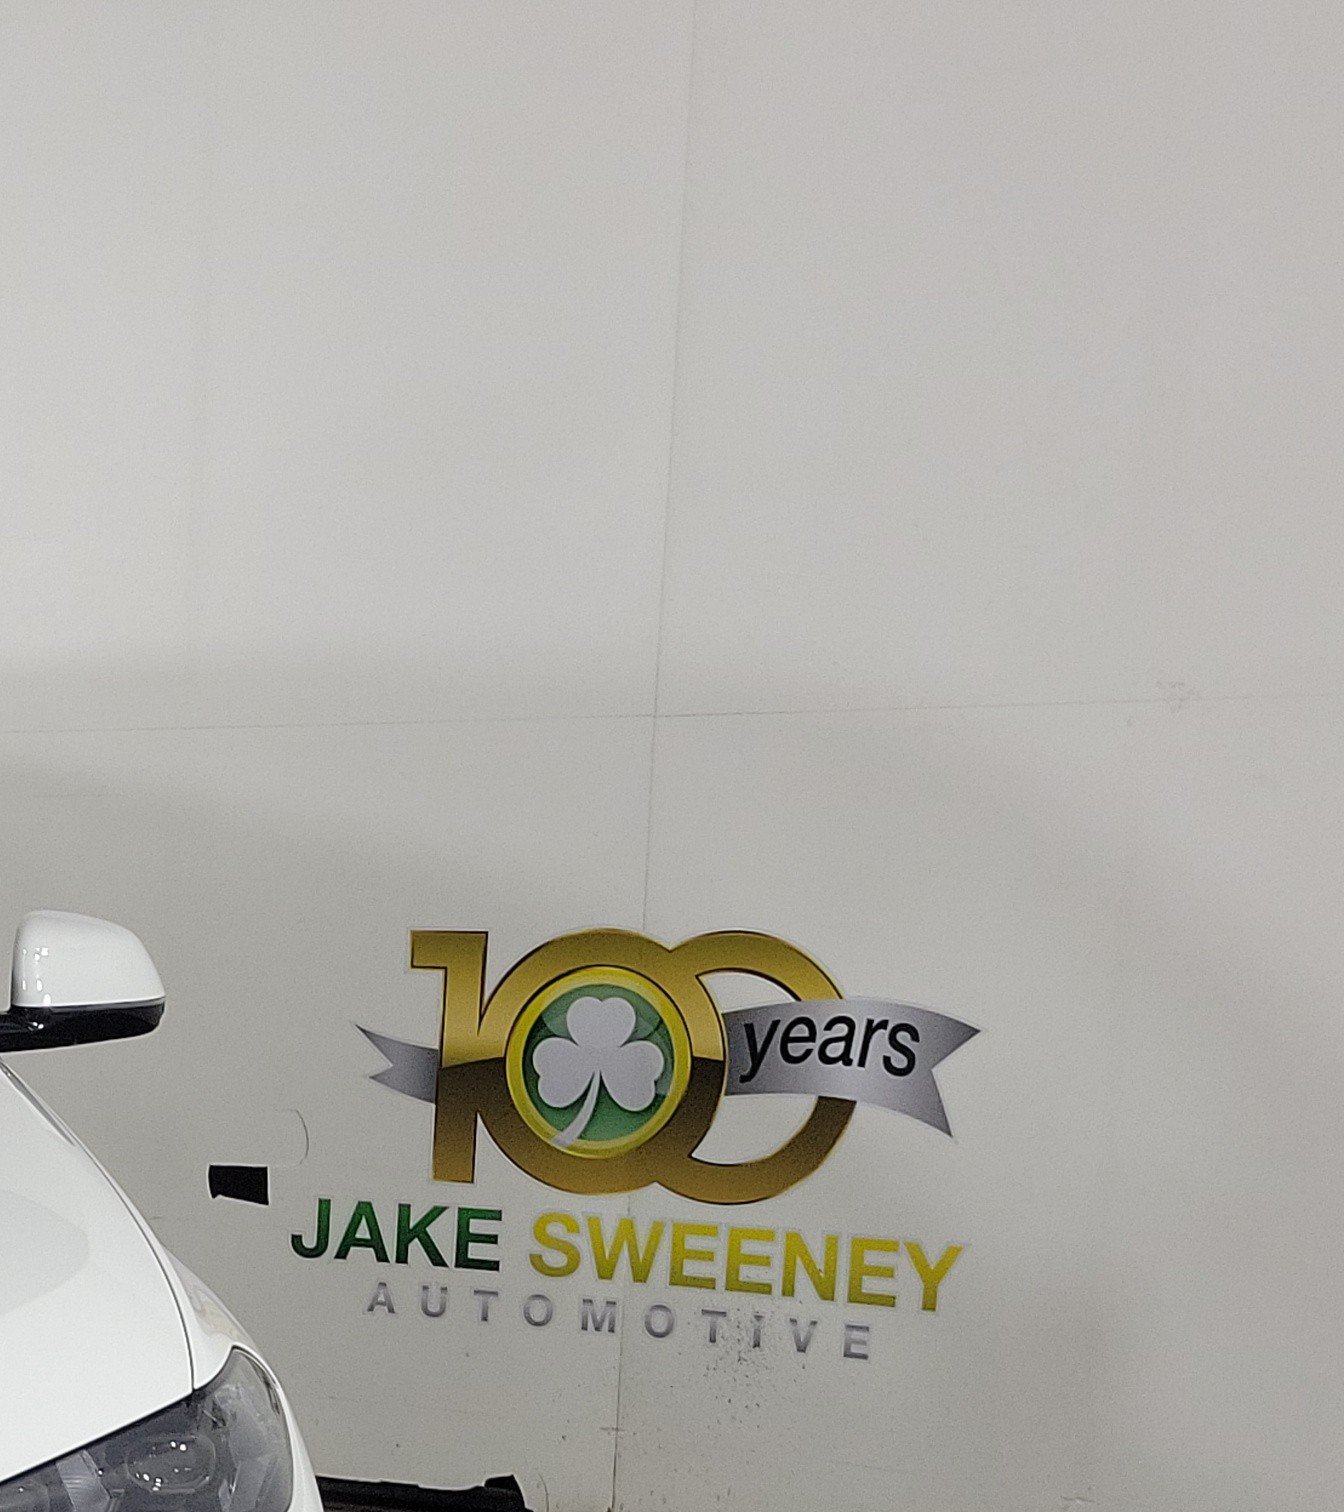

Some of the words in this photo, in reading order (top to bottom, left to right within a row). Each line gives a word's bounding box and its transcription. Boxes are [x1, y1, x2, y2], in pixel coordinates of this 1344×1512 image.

[408, 928, 861, 1206] 100
[738, 1014, 921, 1083] years
[290, 1198, 502, 1272] JAKE
[528, 1210, 962, 1313] SWEENEY
[367, 1281, 871, 1360] AUTOMOTIVE
